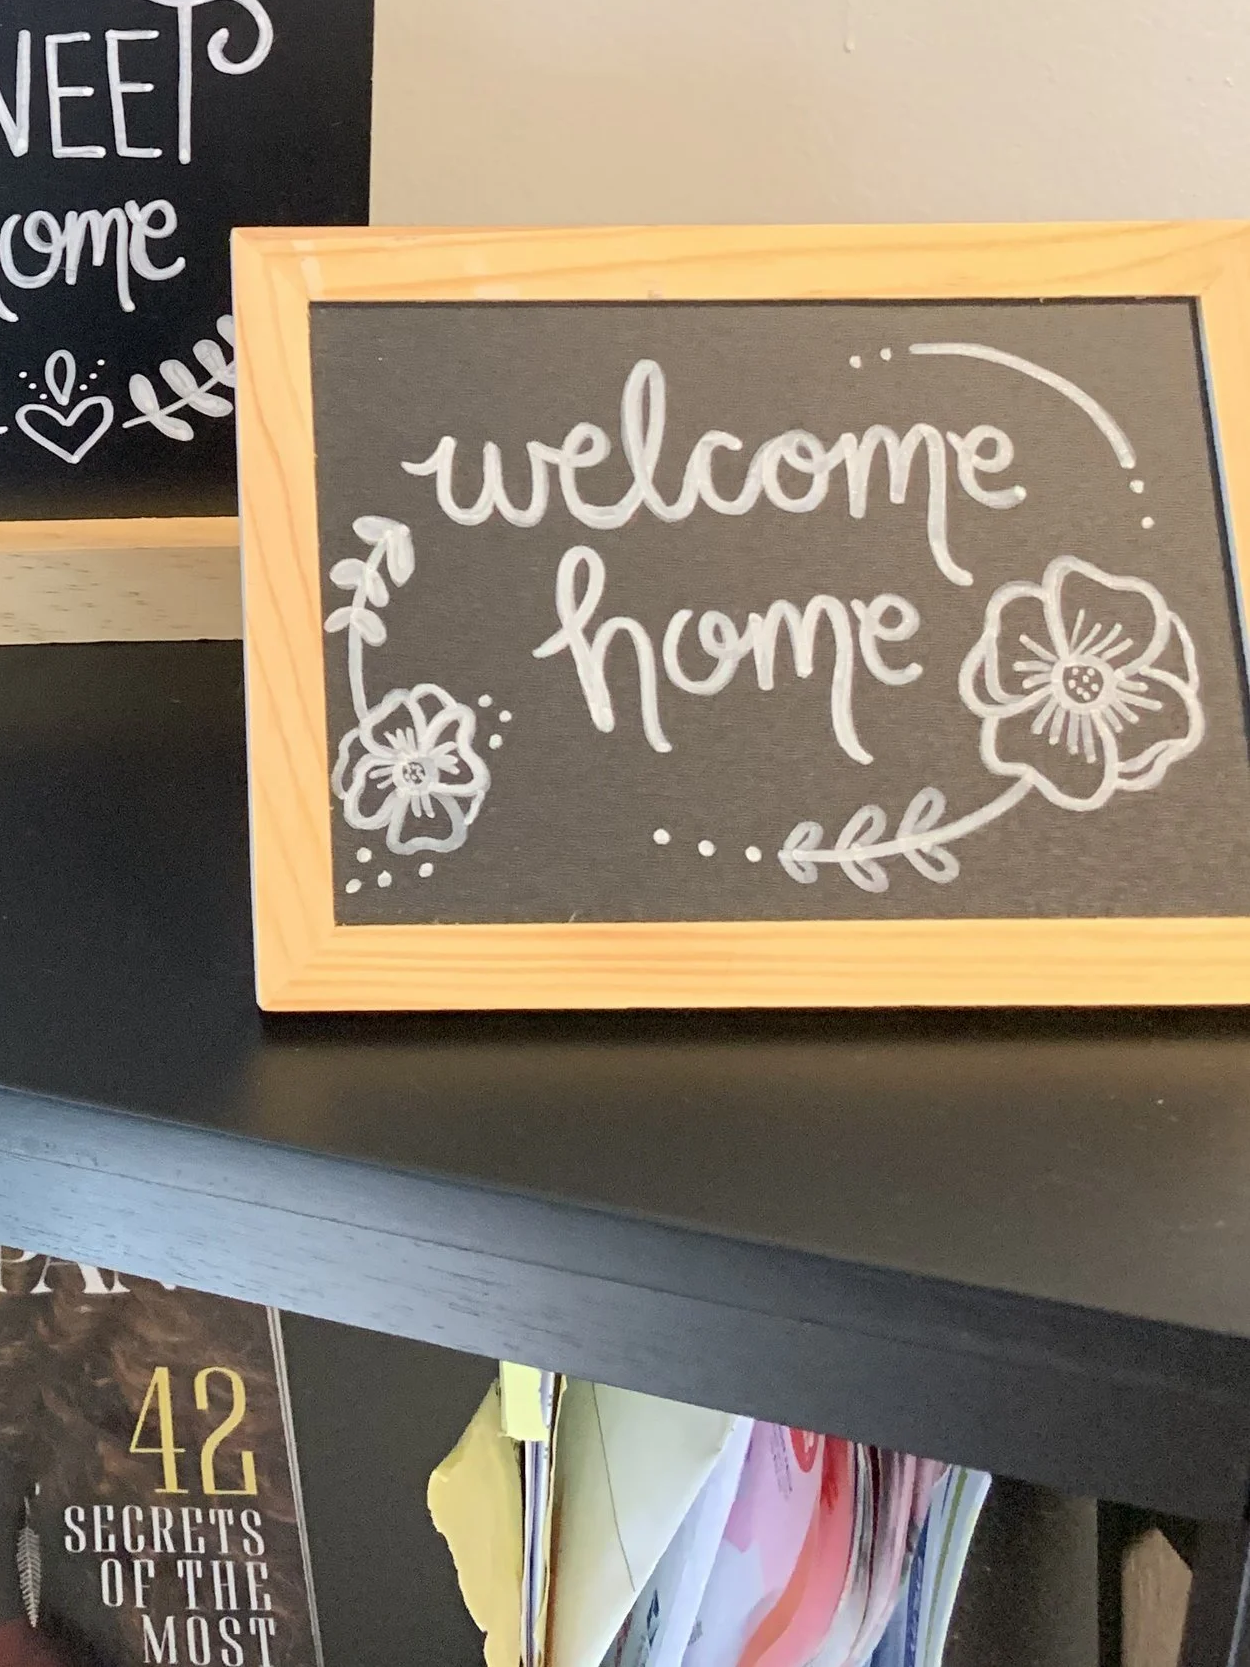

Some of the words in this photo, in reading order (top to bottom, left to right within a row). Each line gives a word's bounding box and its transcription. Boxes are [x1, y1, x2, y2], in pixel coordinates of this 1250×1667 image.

[401, 359, 1027, 586] welcome
[532, 545, 924, 765] home
[129, 1365, 259, 1496] 42
[64, 1504, 266, 1557] SECRETS
[100, 1557, 156, 1609] OF
[177, 1558, 273, 1612] THE
[141, 1613, 276, 1667] MOST
